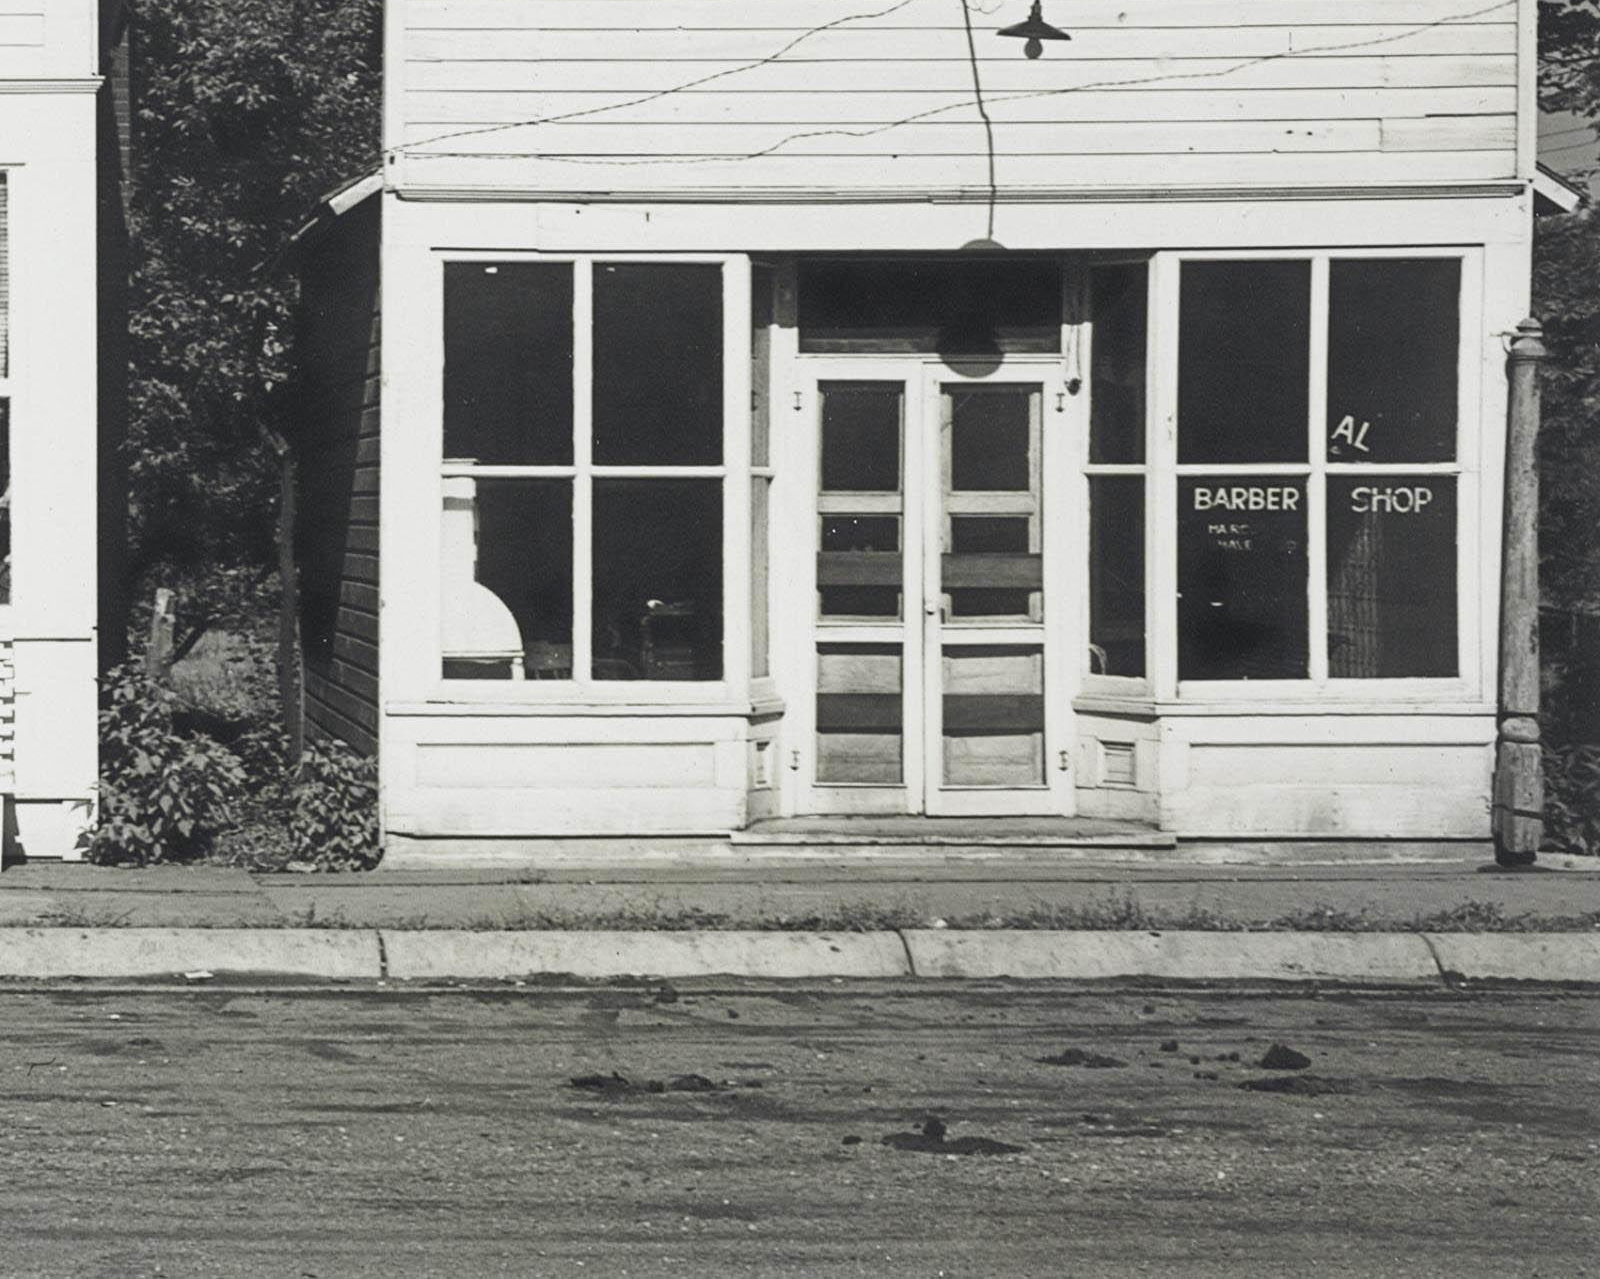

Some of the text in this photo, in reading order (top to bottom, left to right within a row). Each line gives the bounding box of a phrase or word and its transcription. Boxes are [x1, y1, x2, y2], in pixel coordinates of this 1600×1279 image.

[1331, 415, 1371, 453] AL
[1194, 487, 1432, 513] BARBER SHOP
